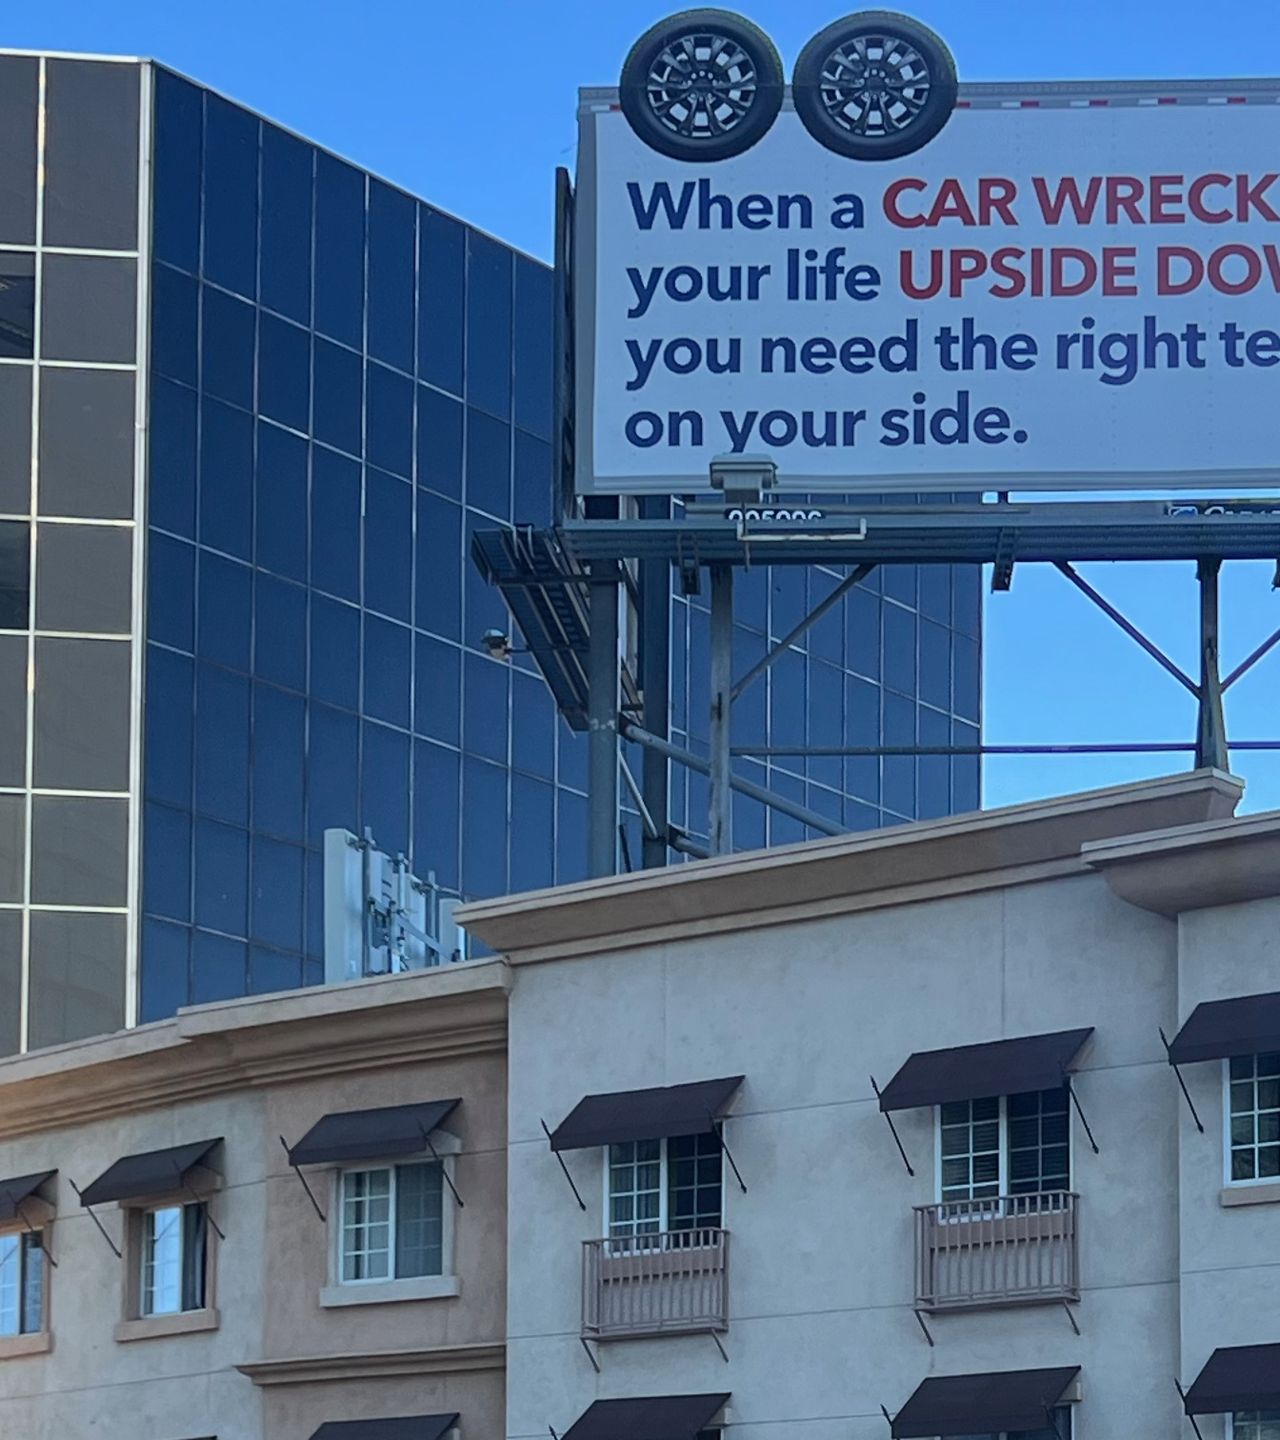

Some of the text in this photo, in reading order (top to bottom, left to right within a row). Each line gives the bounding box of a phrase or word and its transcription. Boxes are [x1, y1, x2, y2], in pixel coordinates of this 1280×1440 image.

[626, 178, 812, 230] When
[830, 194, 864, 228] a
[883, 177, 1018, 228] CAR
[626, 265, 771, 318] your
[787, 247, 880, 300] life
[899, 246, 1138, 299] UPSIDE
[624, 337, 741, 391] you
[761, 319, 918, 373] need
[934, 317, 1038, 371] the
[1057, 315, 1206, 385] right
[624, 391, 1028, 453] on your side.
